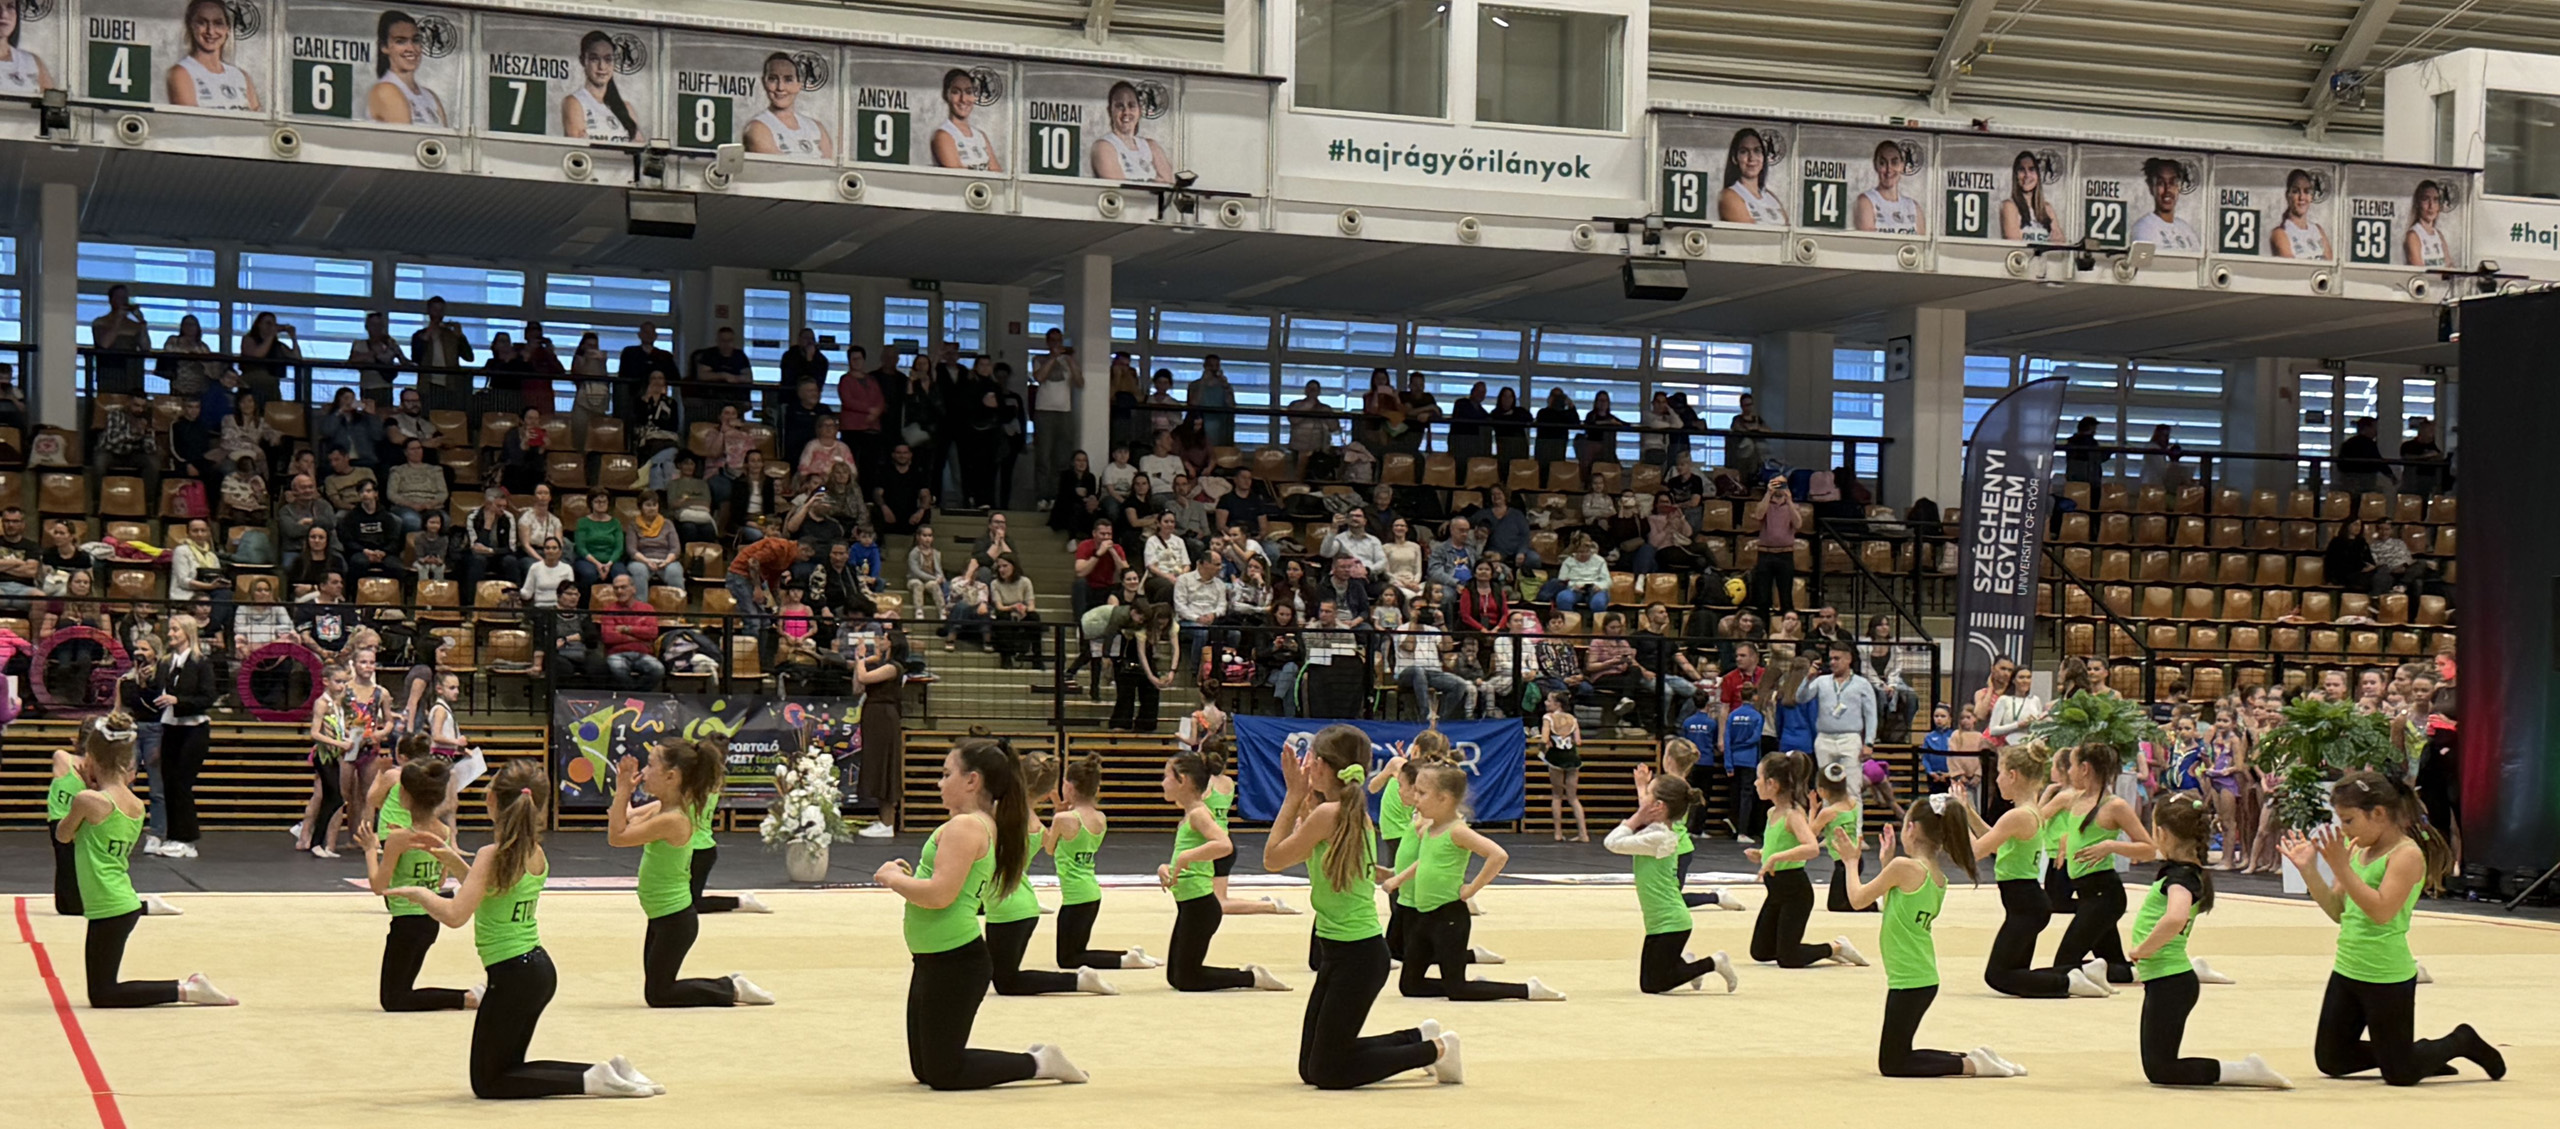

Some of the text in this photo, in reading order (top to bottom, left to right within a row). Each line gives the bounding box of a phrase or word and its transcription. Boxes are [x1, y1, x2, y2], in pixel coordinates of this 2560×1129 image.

[89, 17, 136, 42] DUBEI
[293, 36, 370, 63] CARLETON
[489, 53, 569, 79] MÉSZÁROS
[108, 48, 132, 93] 4
[311, 64, 333, 110] 6
[678, 71, 756, 97] RUFF-NAGY
[508, 82, 527, 125] 7
[858, 87, 910, 110] ANGYAL
[1030, 101, 1082, 123] DOMBAI
[695, 98, 715, 142] 8
[874, 113, 893, 157] 9
[1039, 126, 1071, 170] 10
[1328, 138, 1591, 181] #hajrágyőrilányok
[1663, 148, 1687, 167] ÁCS
[1804, 159, 1846, 179] GARBIN
[1947, 171, 1995, 190] WENTZEL
[1671, 171, 1698, 213] 13
[1811, 183, 1838, 222] 14
[2086, 180, 2120, 198] GOREE
[2221, 189, 2249, 207] BACH
[2352, 199, 2395, 217] TELENGA
[1953, 193, 1981, 232] 19
[2090, 202, 2122, 240] 22
[2224, 211, 2255, 249] 23
[2356, 221, 2386, 258] 33
[1888, 338, 1911, 381] B
[1972, 449, 2007, 593] SZÉCHENYI
[1994, 475, 2026, 595] EGYETEM
[2017, 478, 2040, 596] UNIVERSITY OF GYŐR
[616, 724, 626, 741] 1
[842, 724, 852, 736] 5
